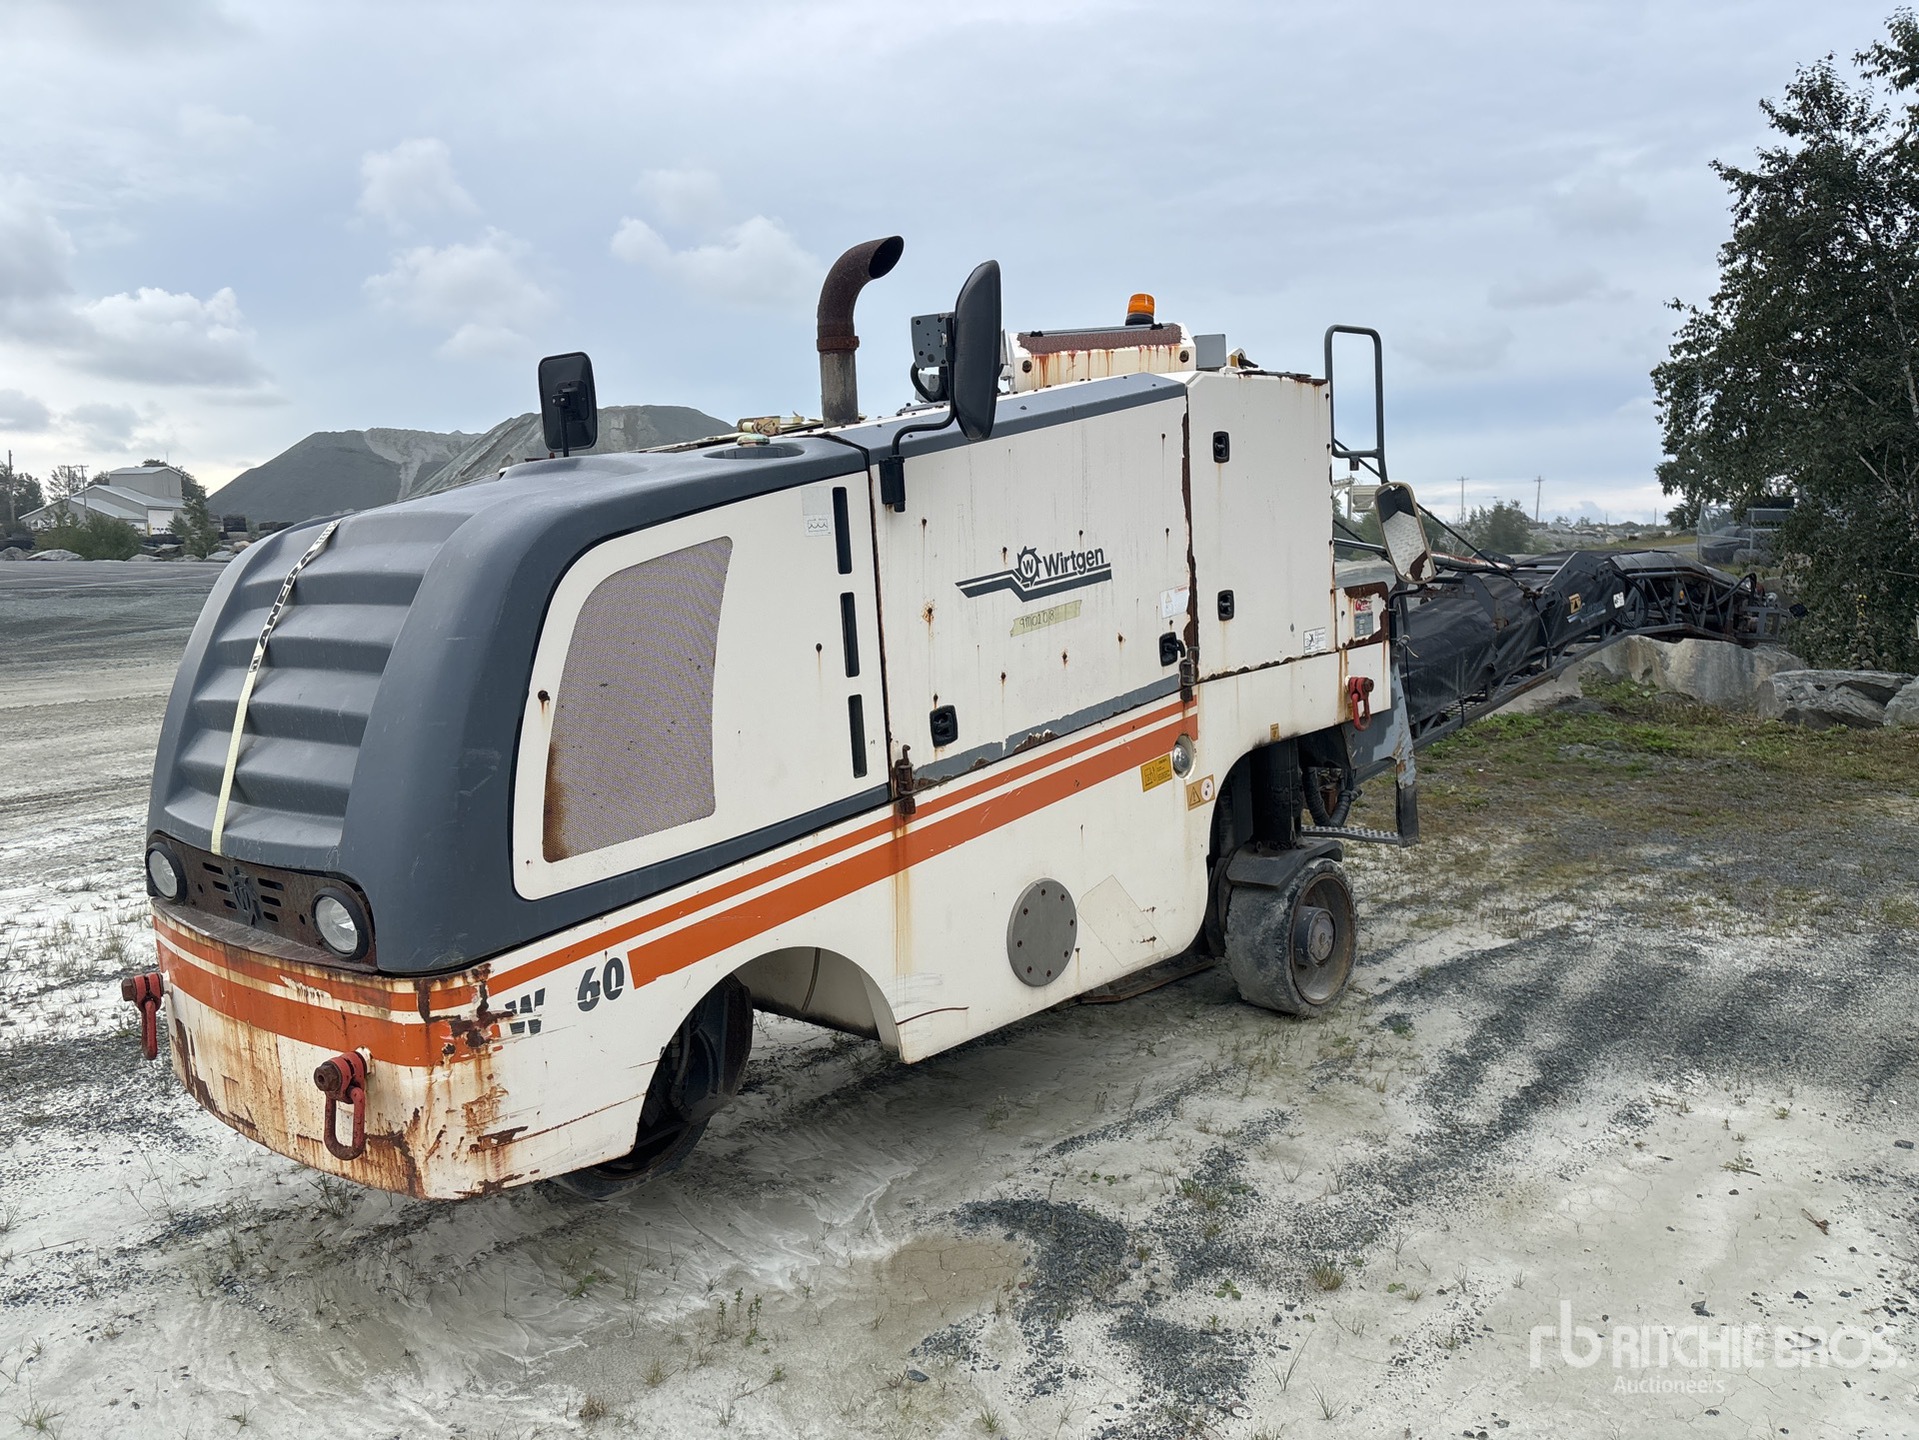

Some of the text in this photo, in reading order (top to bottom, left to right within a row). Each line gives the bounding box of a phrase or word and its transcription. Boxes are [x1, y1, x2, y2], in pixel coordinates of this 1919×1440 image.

[1022, 558, 1035, 575] W
[1042, 547, 1105, 577] Wirtgen
[577, 957, 625, 1012] 60
